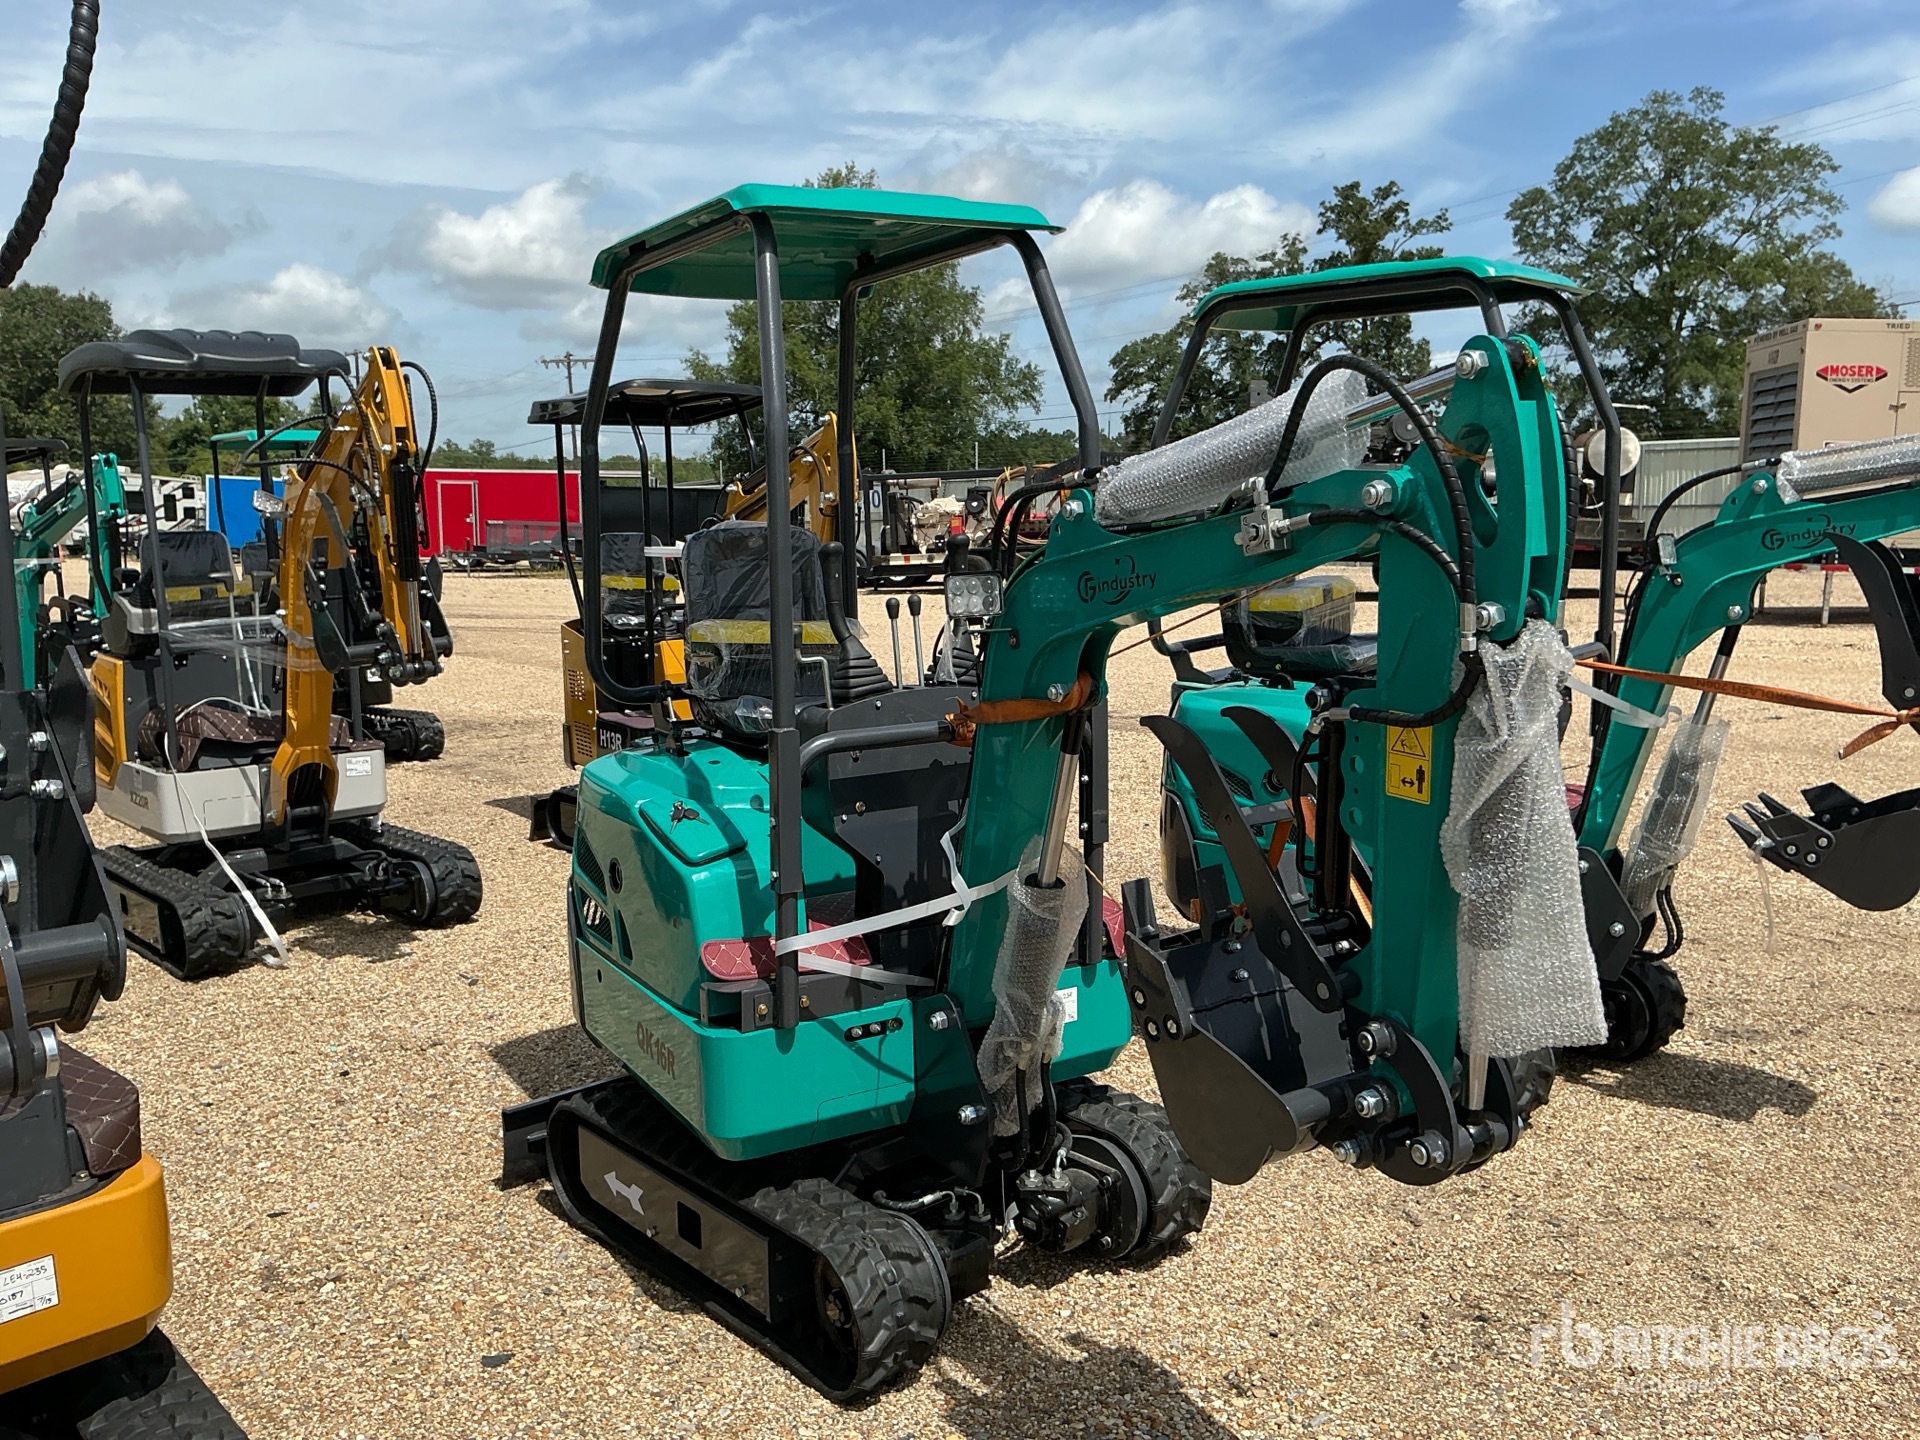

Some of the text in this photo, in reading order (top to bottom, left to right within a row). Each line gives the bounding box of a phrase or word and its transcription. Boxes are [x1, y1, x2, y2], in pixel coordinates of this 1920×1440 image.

[1886, 322, 1911, 330] TRIED
[1829, 364, 1875, 378] MOSER
[599, 728, 622, 751] H13R
[636, 1020, 676, 1081] QK16R
